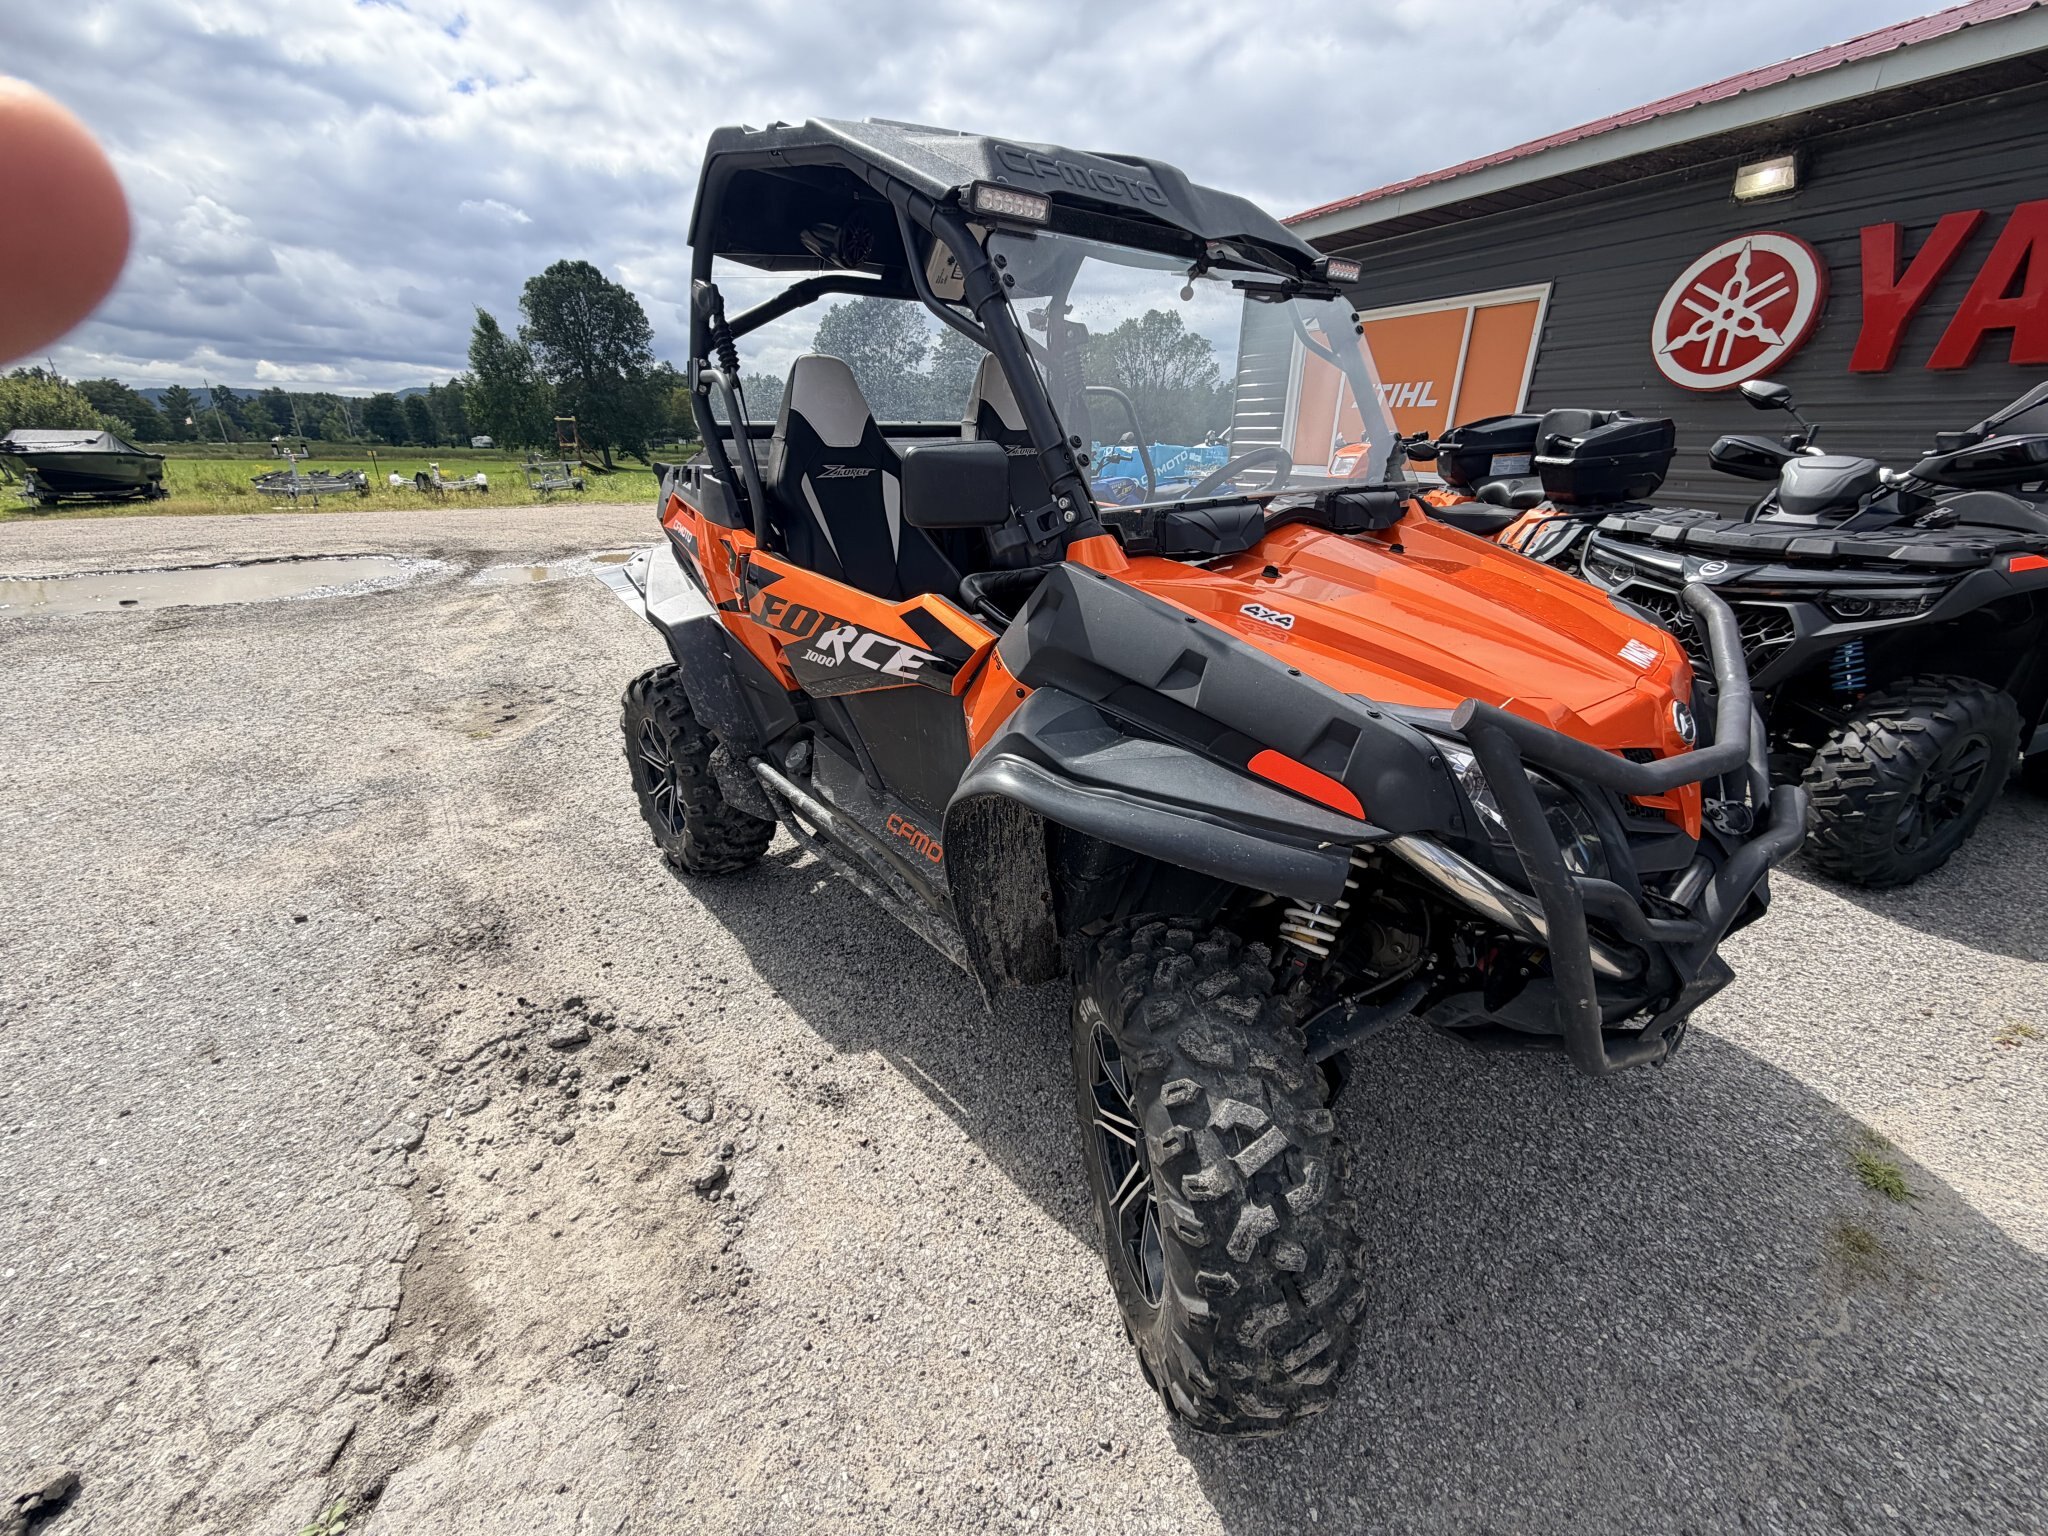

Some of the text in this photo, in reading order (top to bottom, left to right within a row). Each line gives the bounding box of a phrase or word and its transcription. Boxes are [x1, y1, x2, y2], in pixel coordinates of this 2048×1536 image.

[995, 145, 1168, 206] CFMOTO
[1848, 198, 2048, 372] YA
[1351, 381, 1438, 408] TIHL
[1141, 450, 1188, 485] CMOTO
[673, 519, 693, 543] CFMOTO
[801, 649, 835, 668] 1000
[886, 813, 944, 863] CFMO
